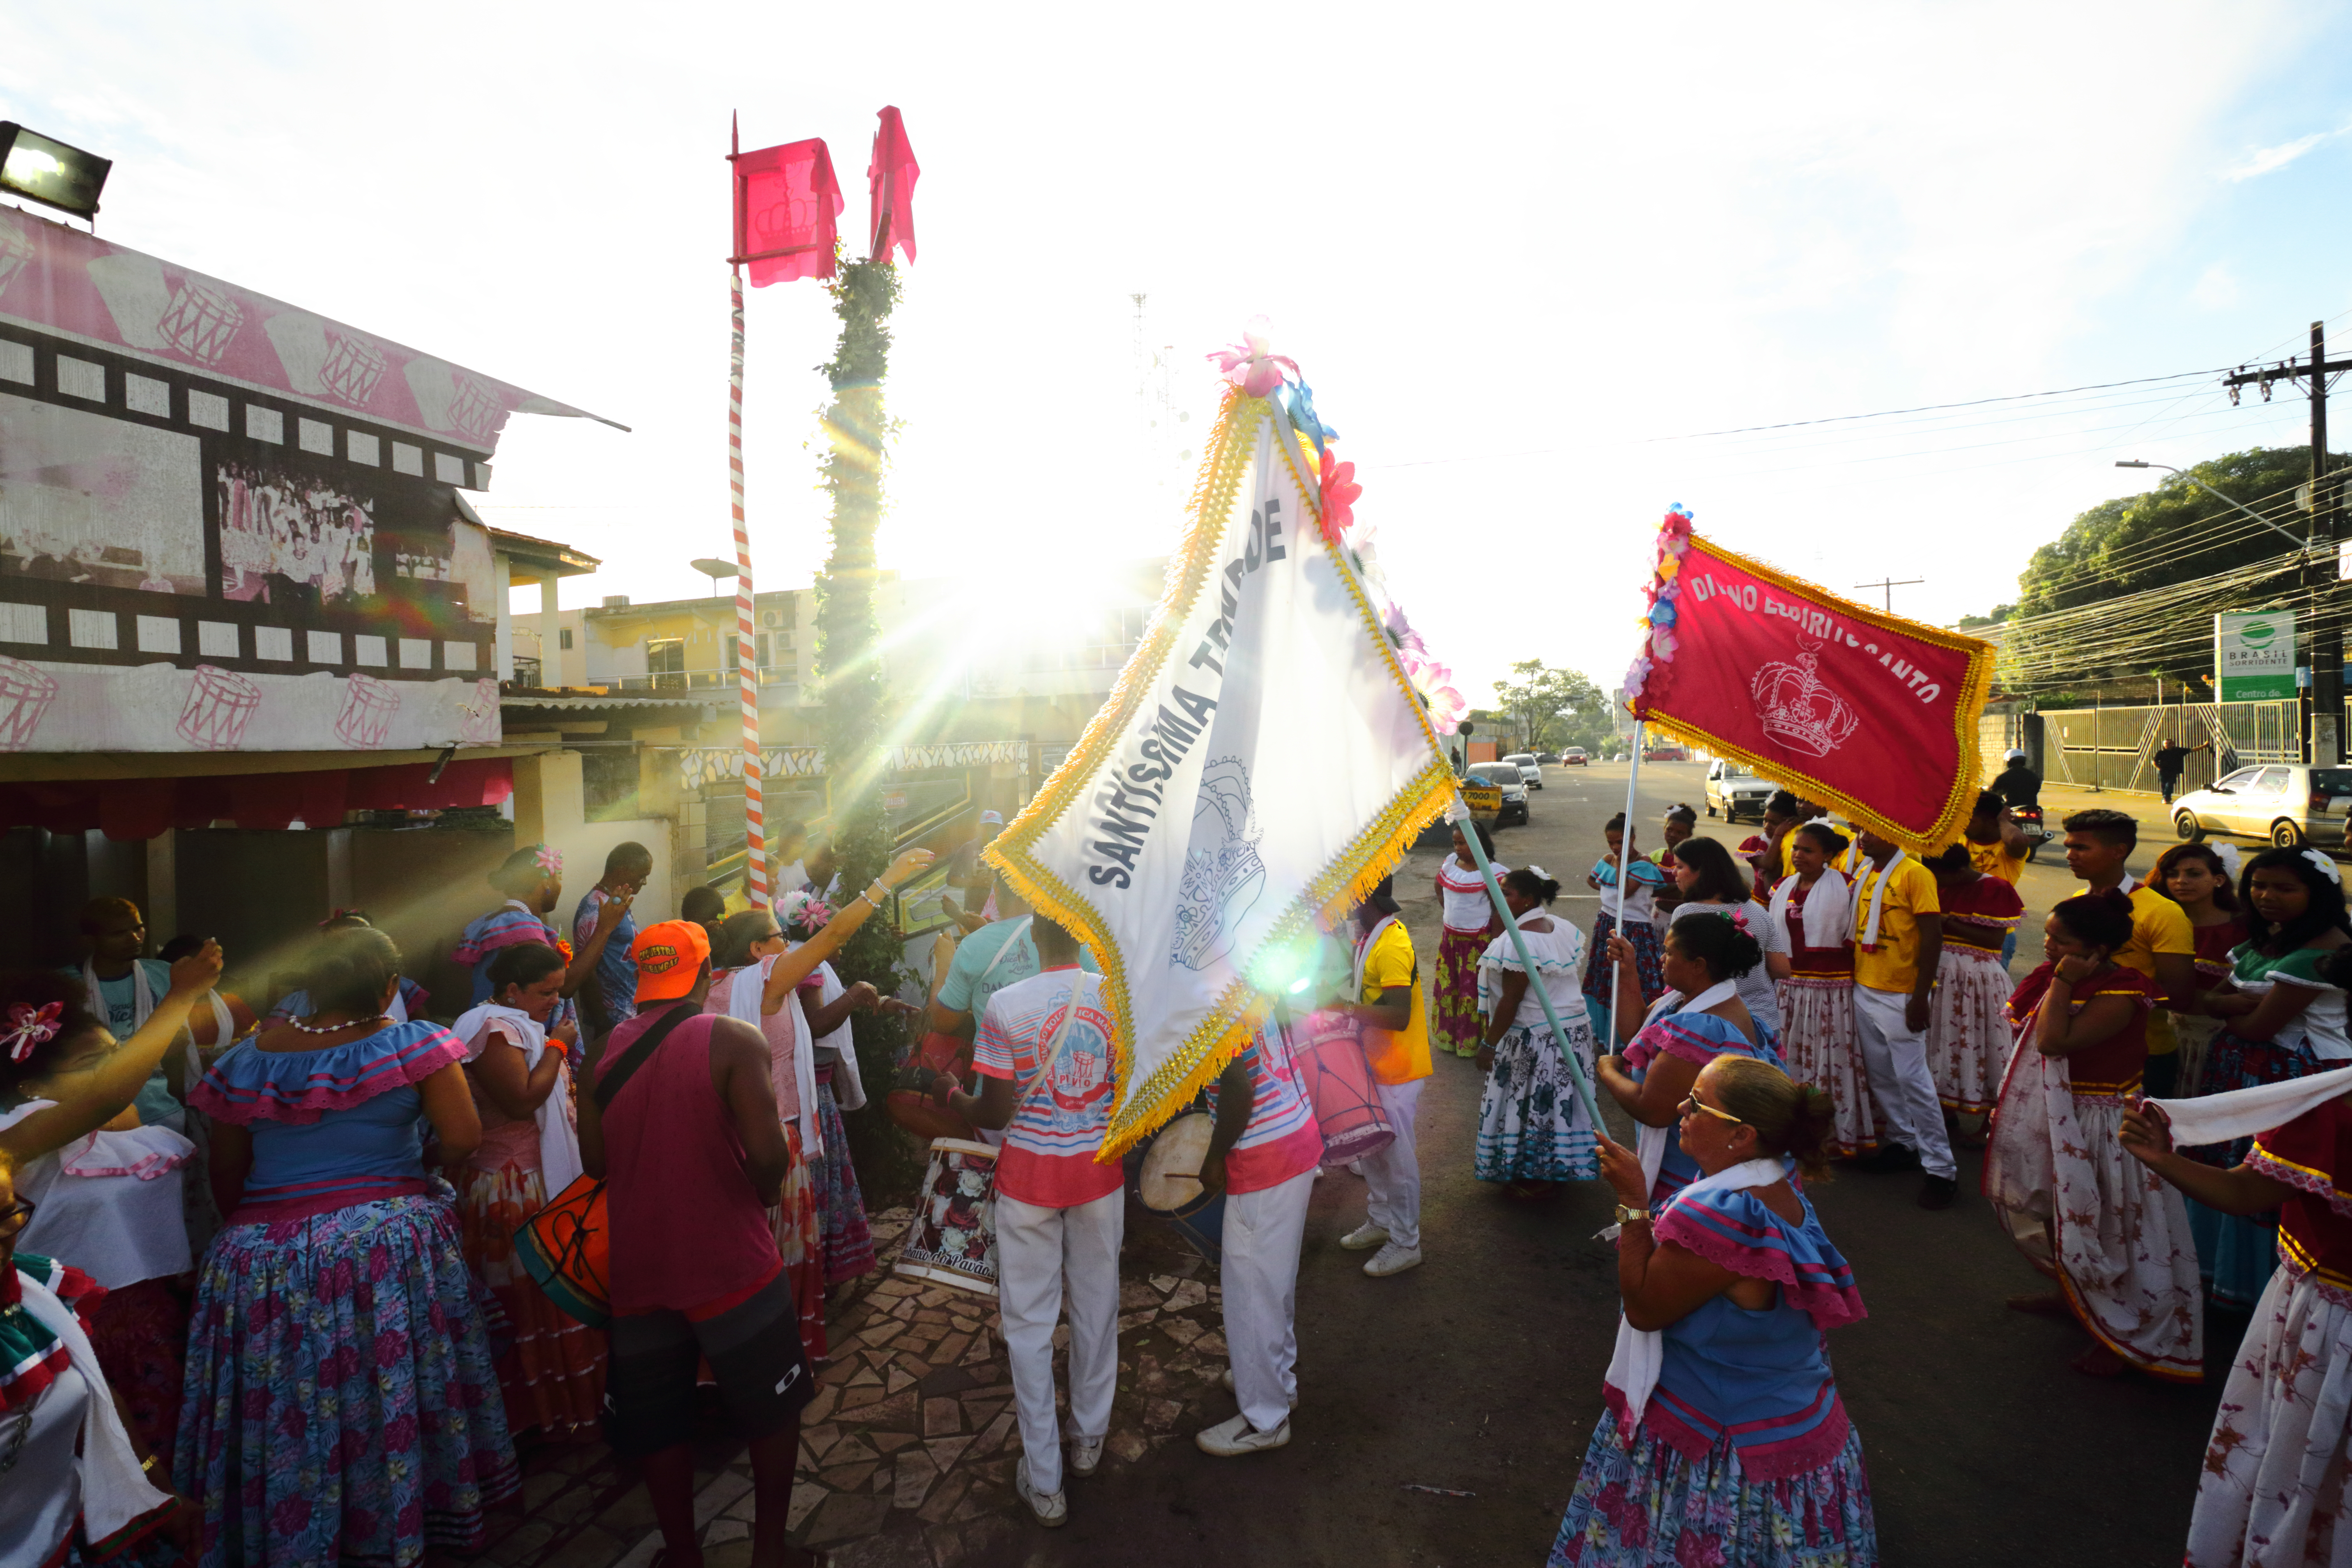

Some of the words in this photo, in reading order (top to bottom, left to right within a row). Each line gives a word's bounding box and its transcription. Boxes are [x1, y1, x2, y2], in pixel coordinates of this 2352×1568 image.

[2229, 650, 2288, 660] BRASIL
[2229, 658, 2287, 666] SORRIDENTE
[2235, 690, 2267, 699] Centro
[2268, 689, 2281, 697] de
[1468, 791, 1490, 800] 7000
[649, 957, 679, 973] BAMBAS
[951, 1254, 990, 1276] Pavão
